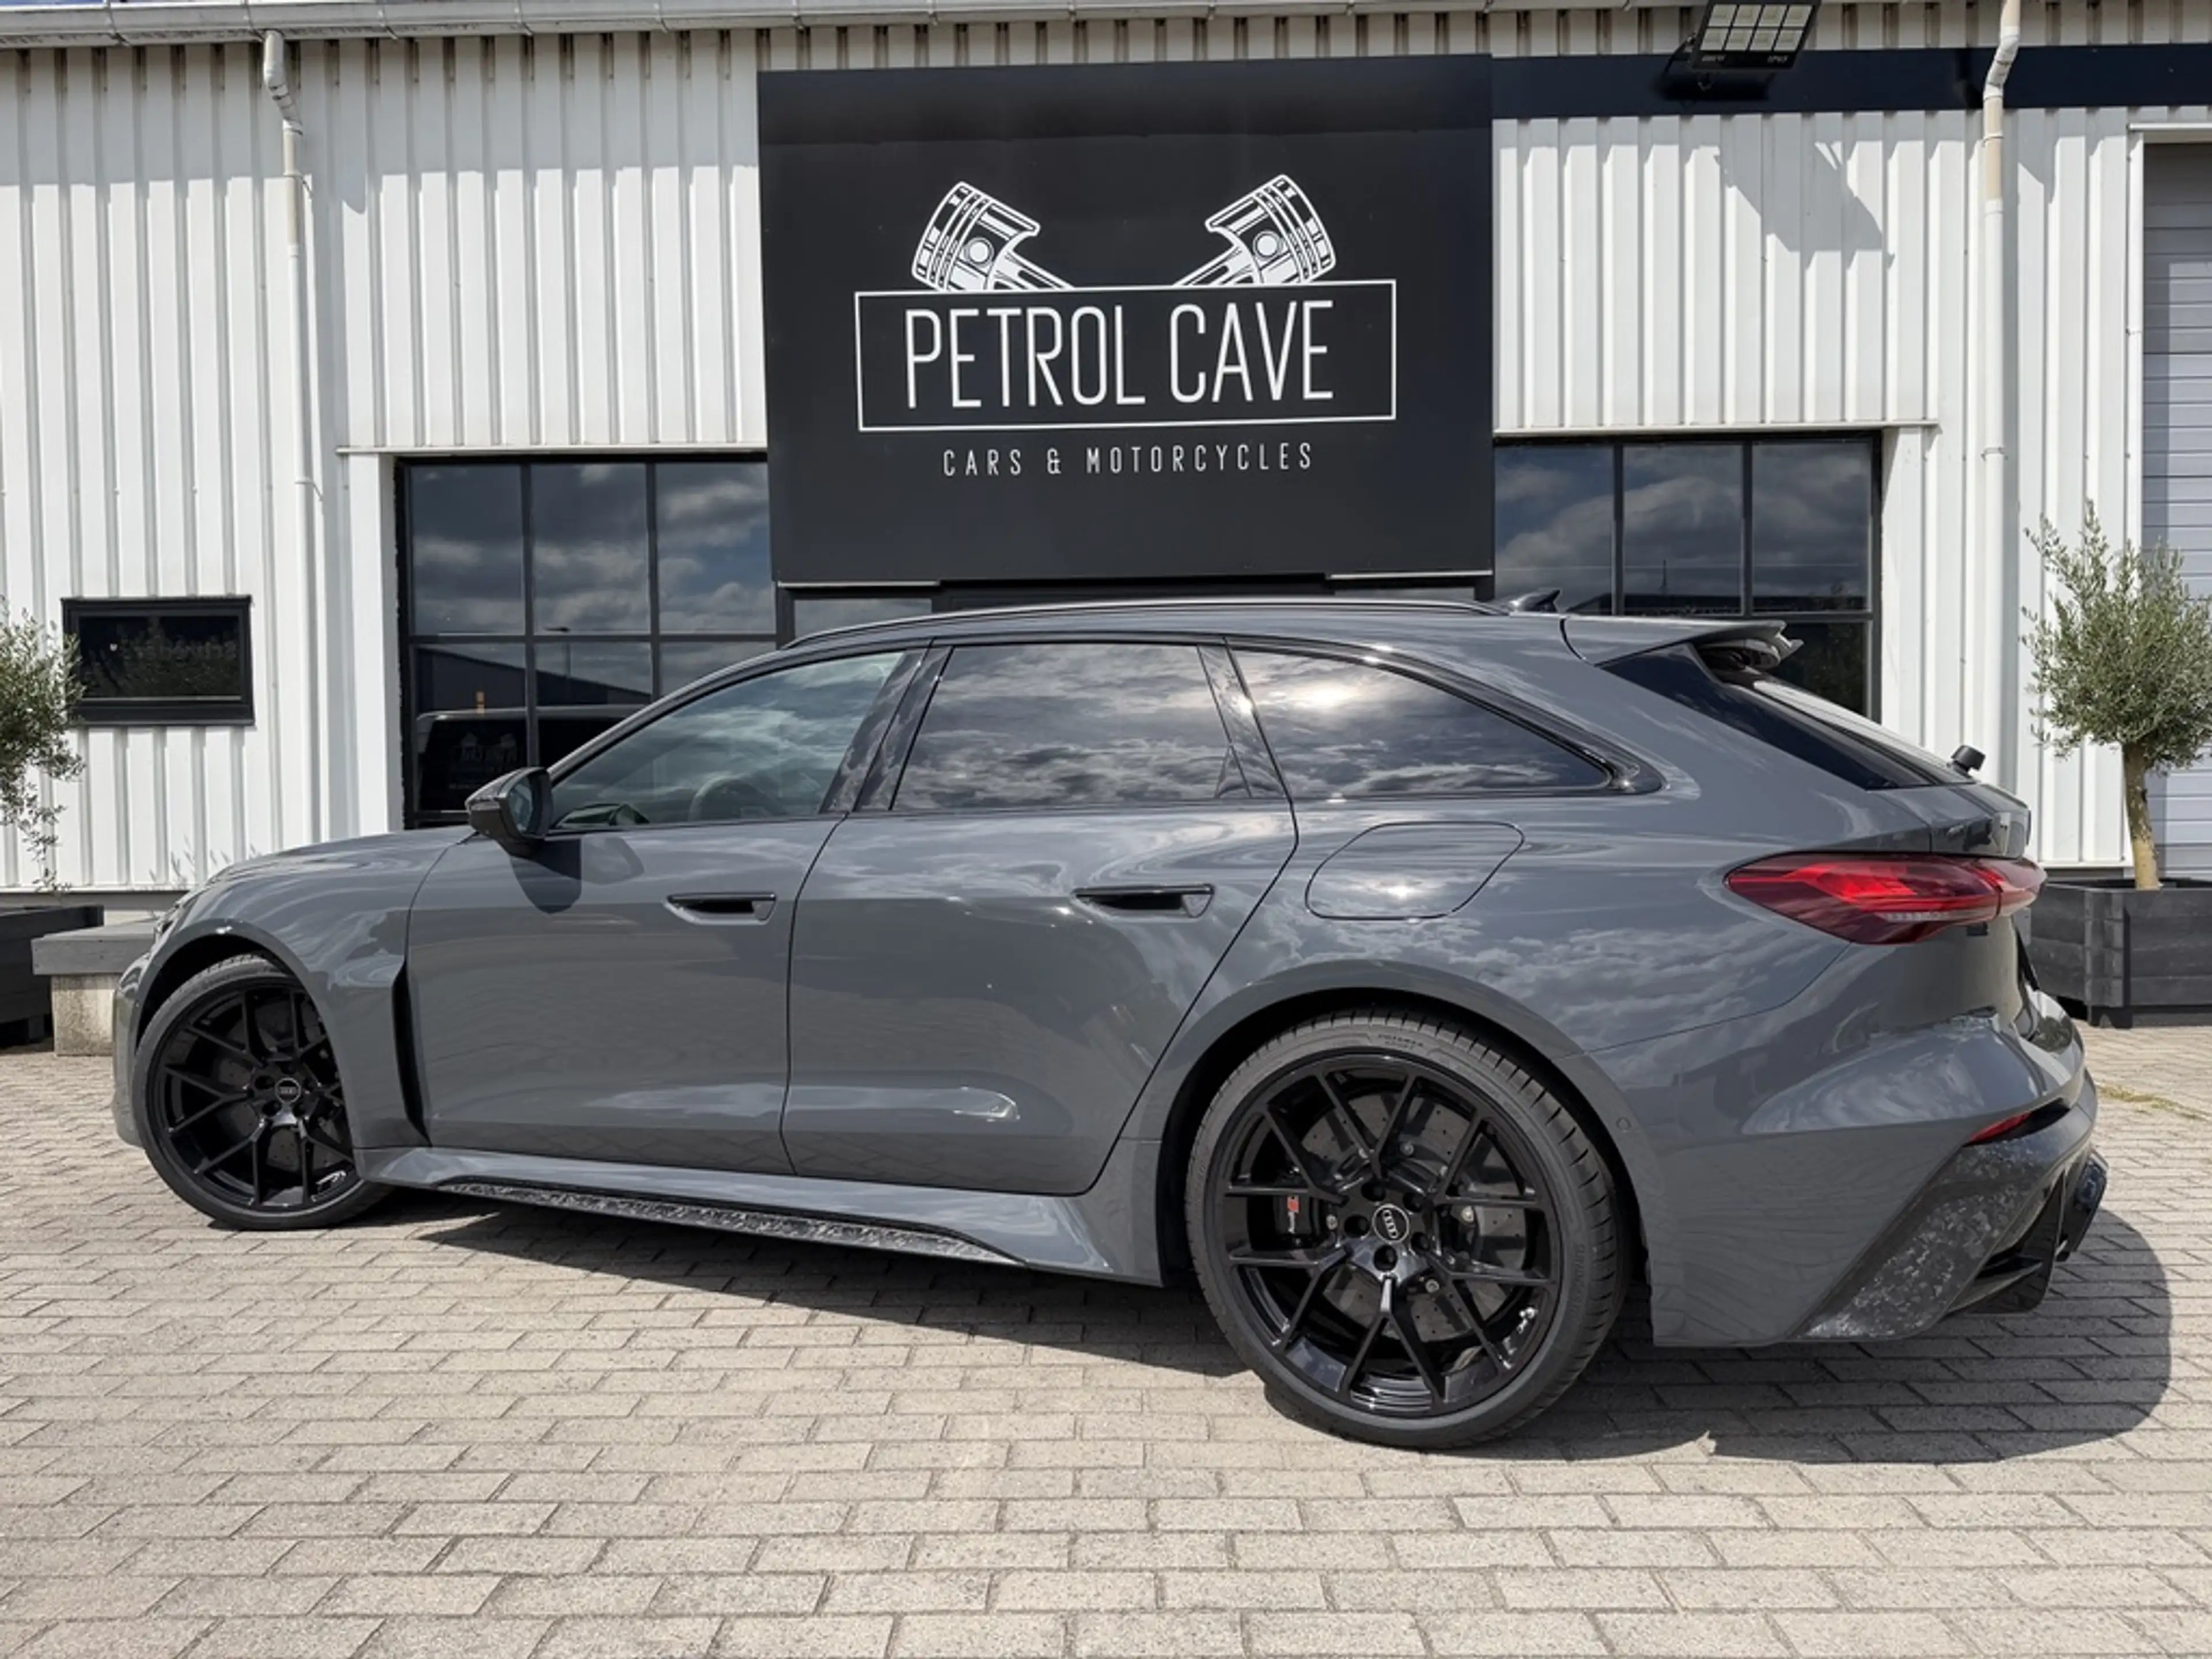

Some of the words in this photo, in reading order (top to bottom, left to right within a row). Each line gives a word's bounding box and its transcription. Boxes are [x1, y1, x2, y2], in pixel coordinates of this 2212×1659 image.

[906, 305, 1146, 409] PETROL
[1170, 300, 1334, 403] CAVE
[944, 449, 1022, 476] CARS
[1047, 448, 1061, 475] &
[1086, 442, 1310, 474] MOTORCYCLES
